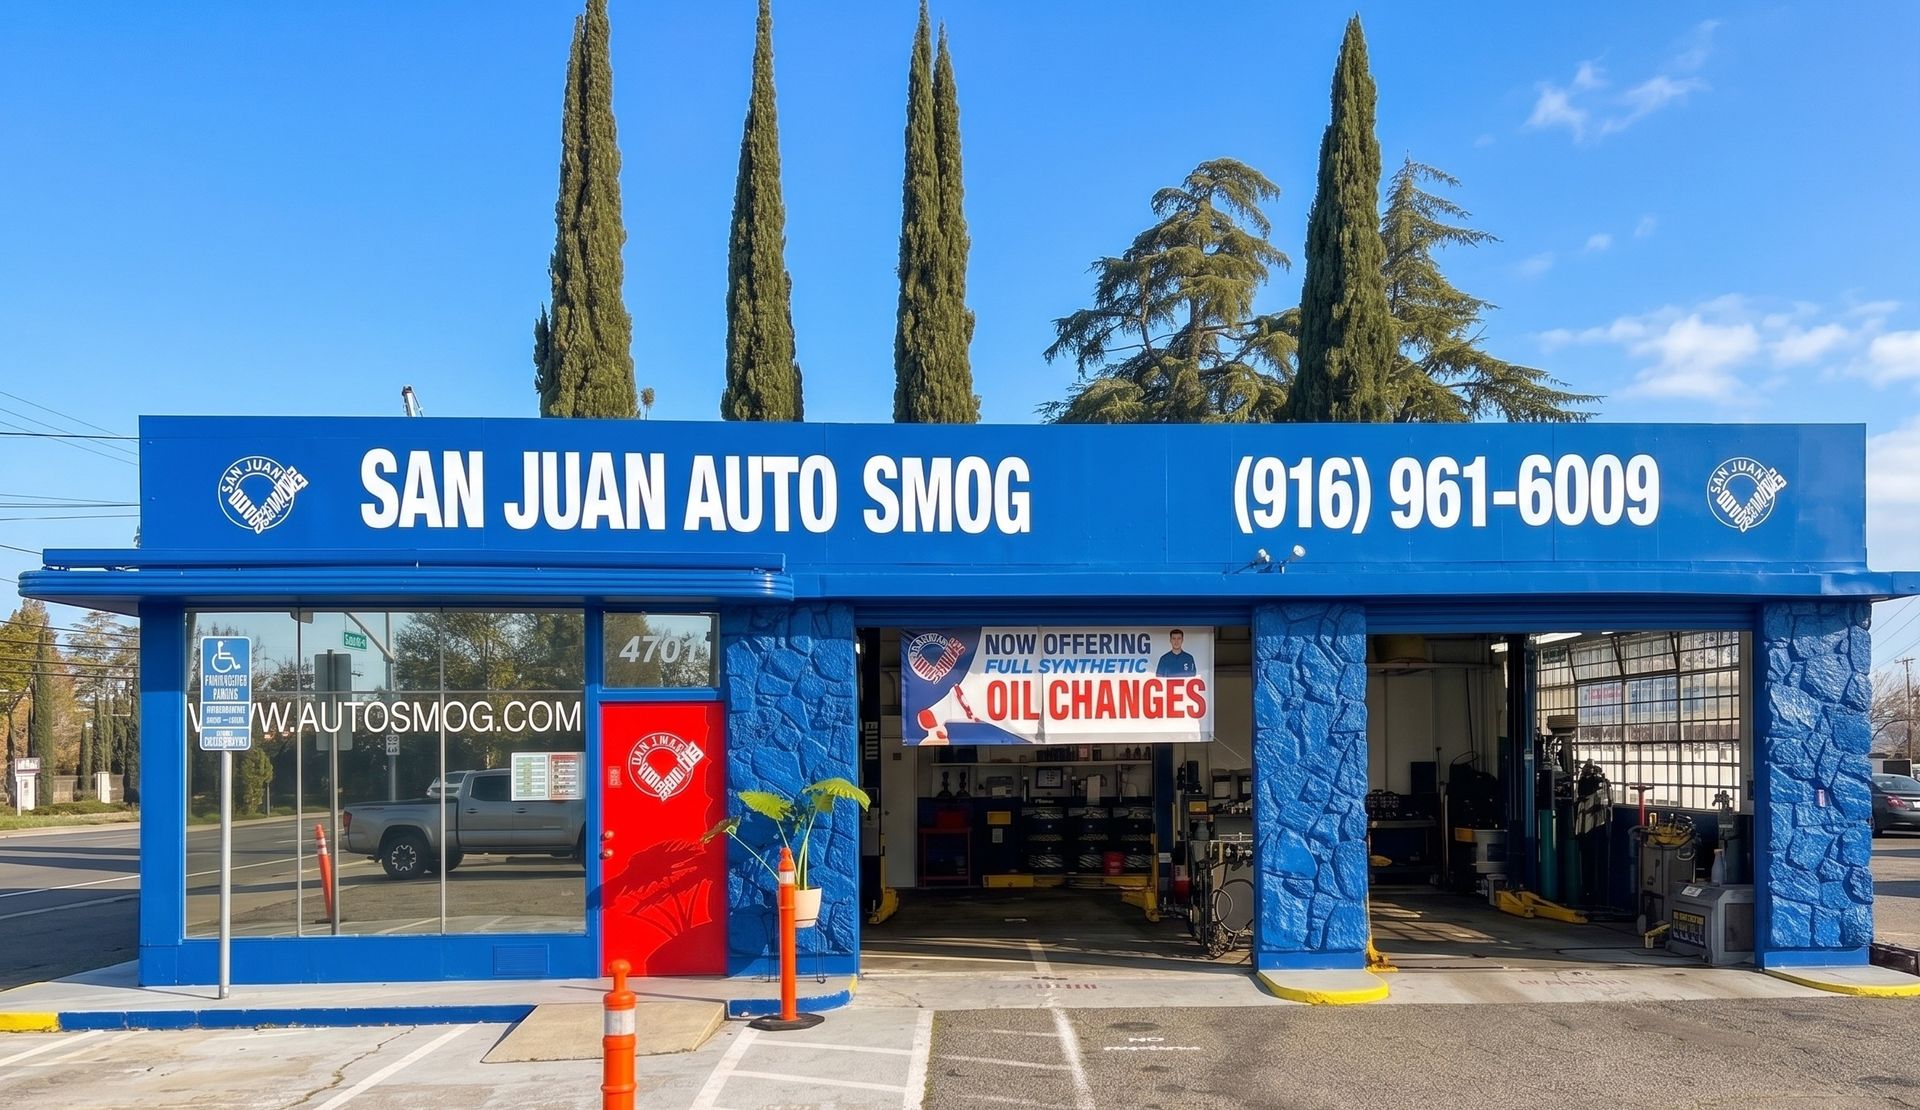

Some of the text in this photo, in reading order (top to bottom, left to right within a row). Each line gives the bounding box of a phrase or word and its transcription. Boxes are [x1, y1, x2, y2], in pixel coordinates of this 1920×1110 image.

[222, 459, 283, 494] SAN JUAN
[360, 448, 484, 529] SAN
[503, 451, 666, 530] JUAN
[683, 454, 838, 533] AUTO
[863, 455, 1031, 535] SMOG
[1234, 456, 1372, 534] (916)
[1389, 453, 1660, 529] 961-6009
[1711, 460, 1766, 494] SAN JUAN
[619, 635, 700, 663] 4701
[984, 632, 1152, 655] NOW OFFERING
[984, 658, 1148, 674] FULL SYNTHETIC
[187, 700, 581, 733] W.AUTOSMOG.COM
[986, 678, 1207, 721] OIL CHANGES
